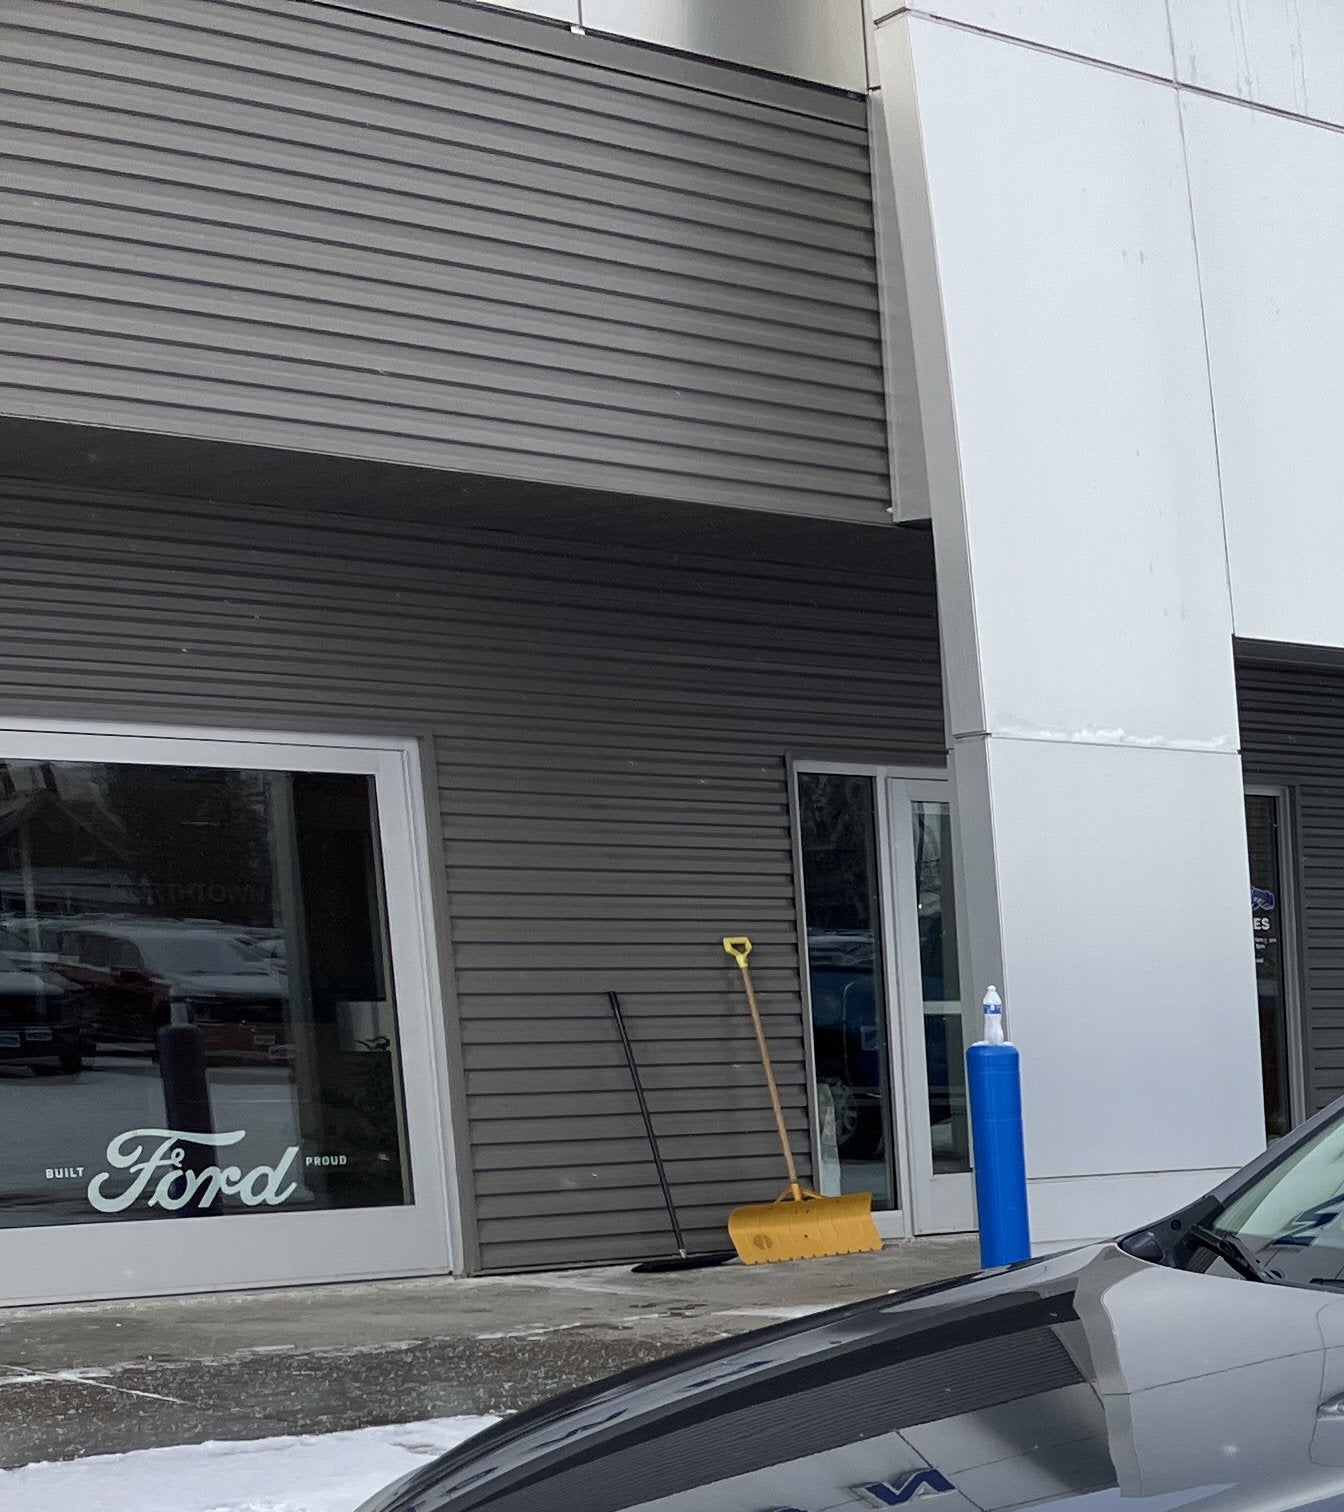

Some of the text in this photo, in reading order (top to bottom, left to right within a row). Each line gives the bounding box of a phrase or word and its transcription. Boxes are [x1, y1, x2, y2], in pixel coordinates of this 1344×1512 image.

[45, 1128, 348, 1213] BUILT Ford PROUD
